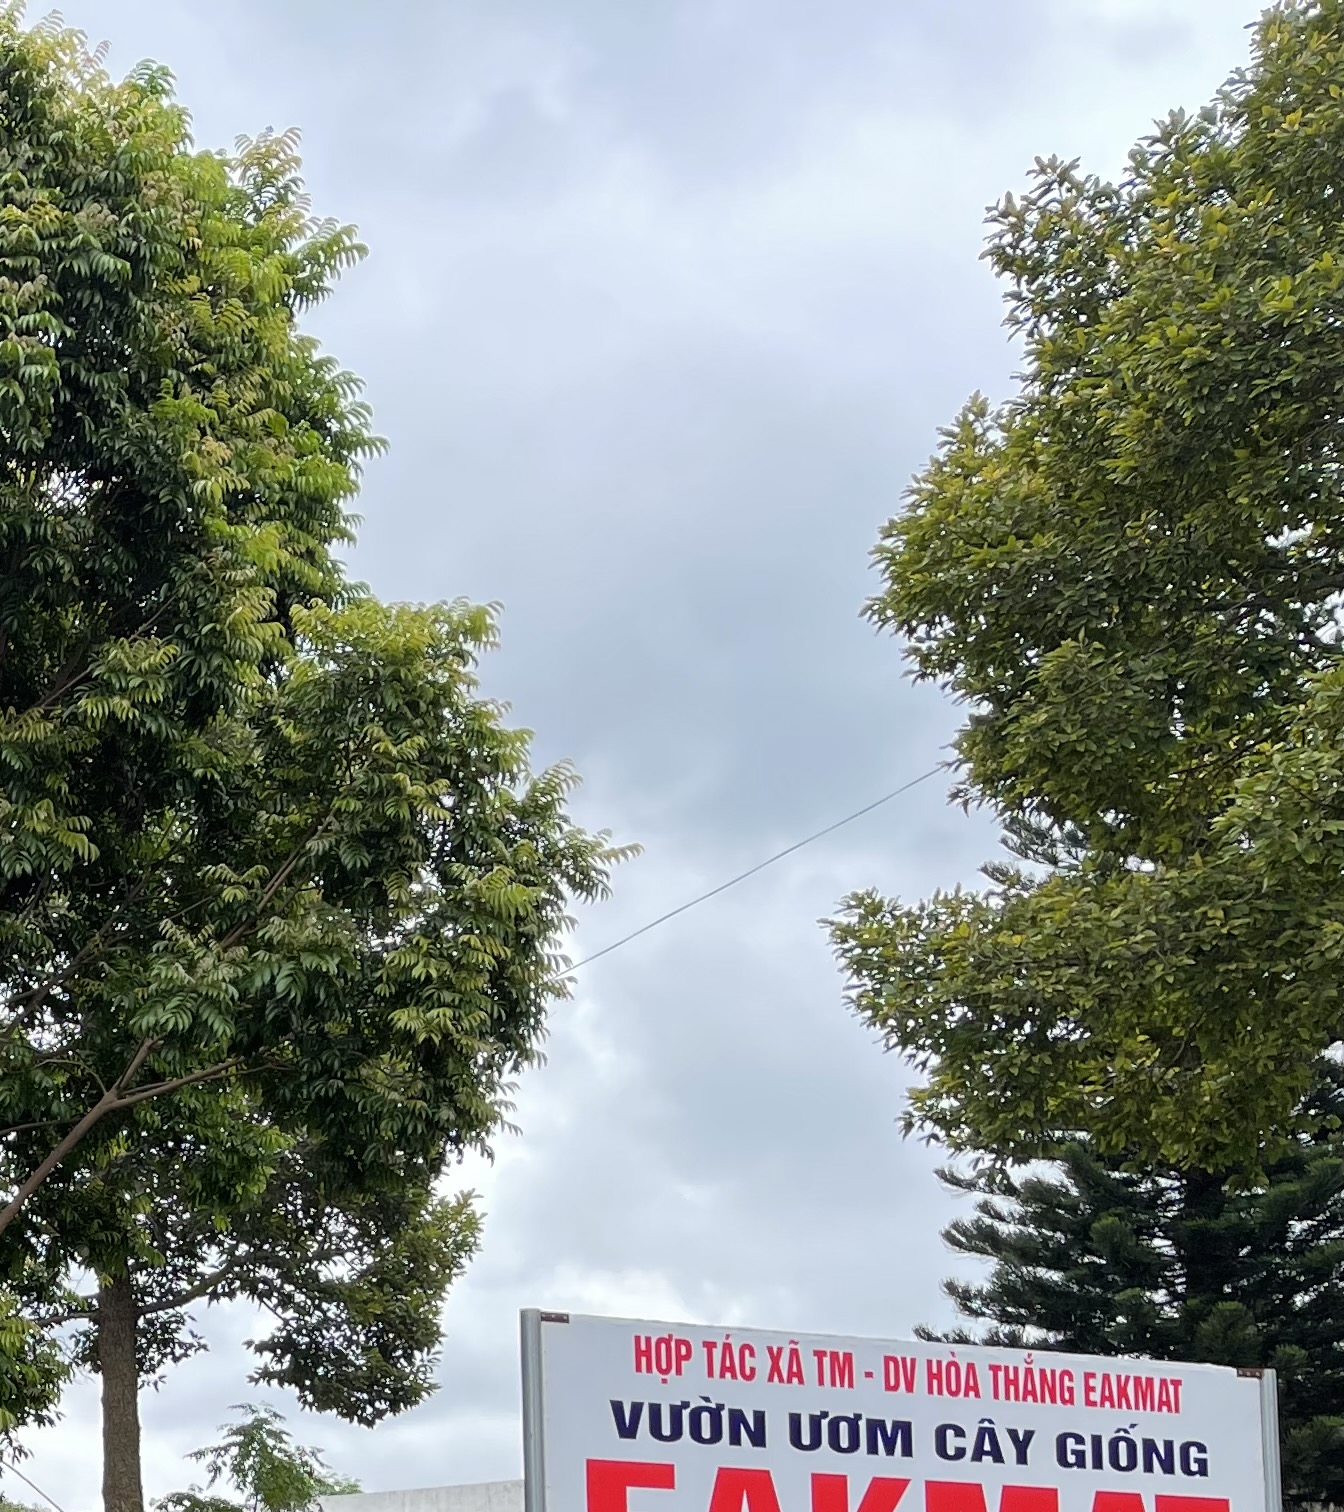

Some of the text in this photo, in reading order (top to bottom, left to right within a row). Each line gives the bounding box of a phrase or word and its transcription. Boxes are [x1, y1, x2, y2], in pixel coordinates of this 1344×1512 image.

[635, 1336, 692, 1375] HỢP
[702, 1335, 758, 1381] TÁC
[767, 1340, 806, 1385] XÃ
[815, 1350, 854, 1387] TM
[884, 1356, 916, 1392] DV
[926, 1351, 982, 1399] HÒA
[989, 1352, 1075, 1405] THẮNG
[1084, 1373, 1181, 1412] EAKMAT
[610, 1396, 1208, 1477] VƯỜN ƯƠM CÂY GIỐNG
